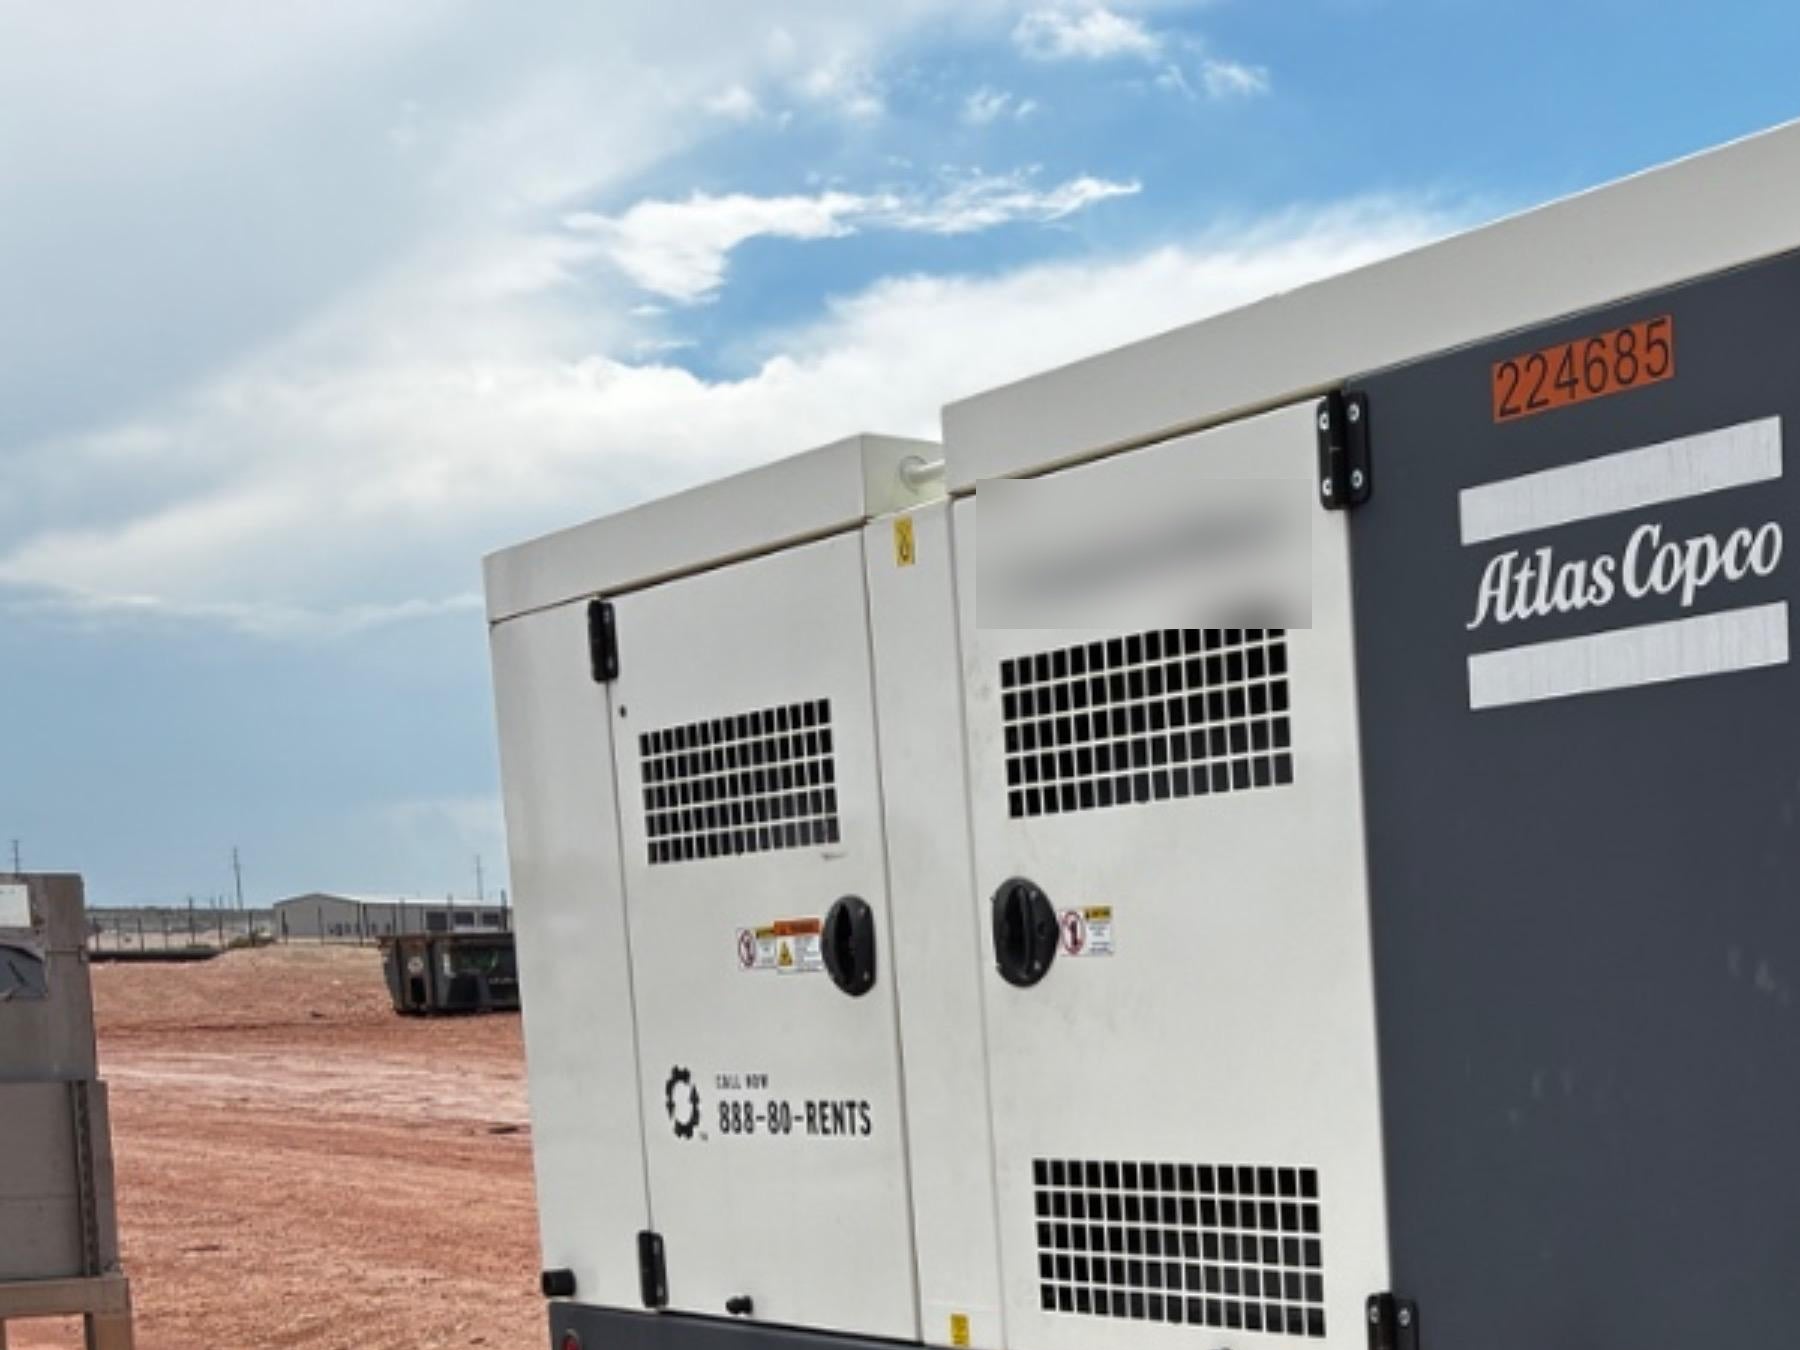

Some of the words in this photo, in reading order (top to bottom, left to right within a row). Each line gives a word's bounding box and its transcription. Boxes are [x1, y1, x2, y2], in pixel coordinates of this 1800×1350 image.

[1496, 318, 1671, 418] 224685
[1466, 547, 1616, 631] Atlas
[1621, 521, 1784, 607] Copco
[718, 1100, 871, 1136] 888-80-RENTS
